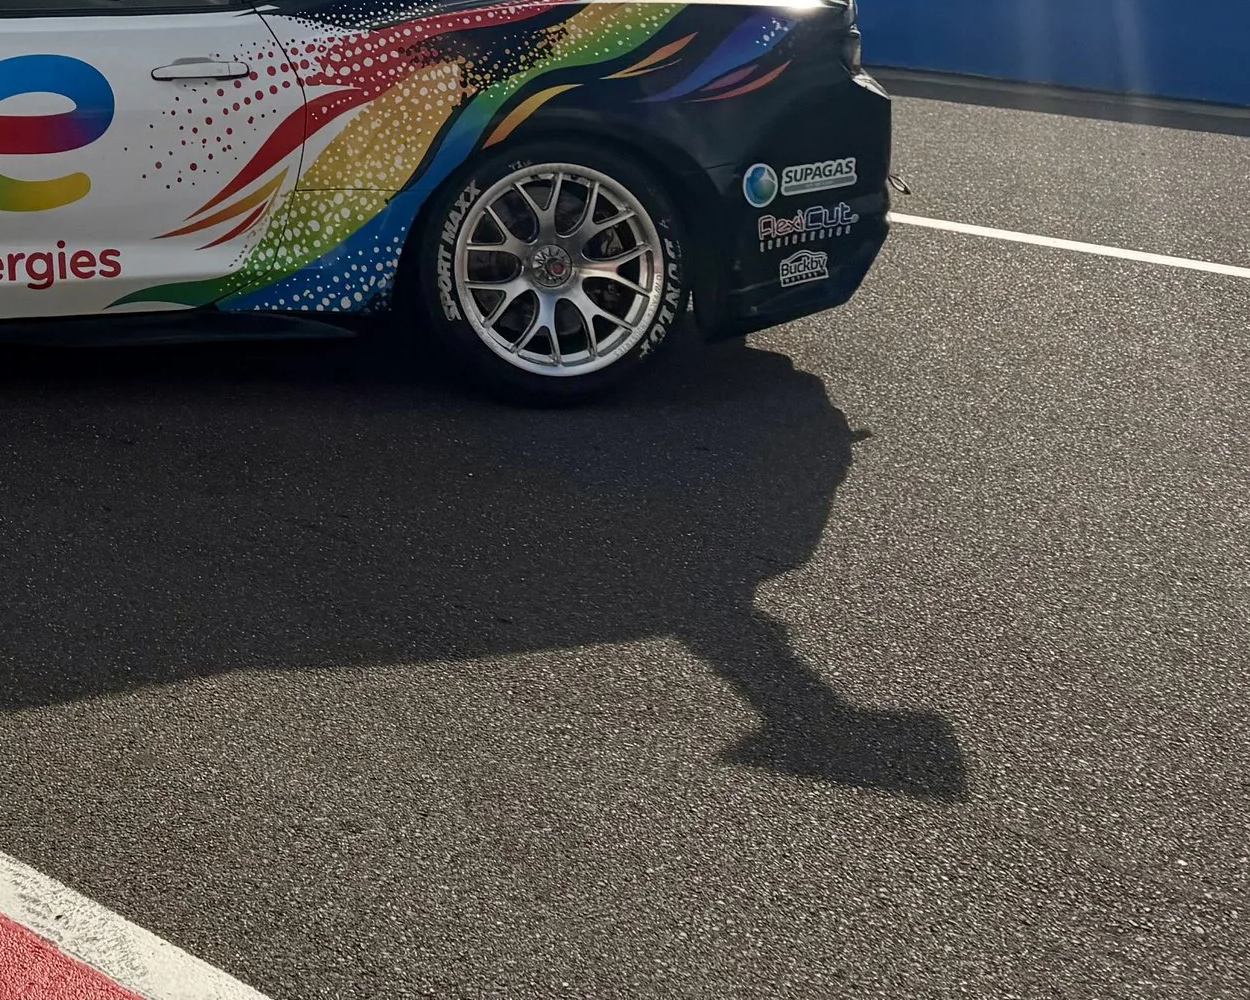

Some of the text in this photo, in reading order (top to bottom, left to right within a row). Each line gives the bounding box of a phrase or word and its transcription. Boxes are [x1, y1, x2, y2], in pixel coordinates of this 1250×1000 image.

[784, 160, 854, 184] SUPAGAS
[437, 179, 481, 321] SPORT MAXX
[781, 255, 828, 278] Buckby
